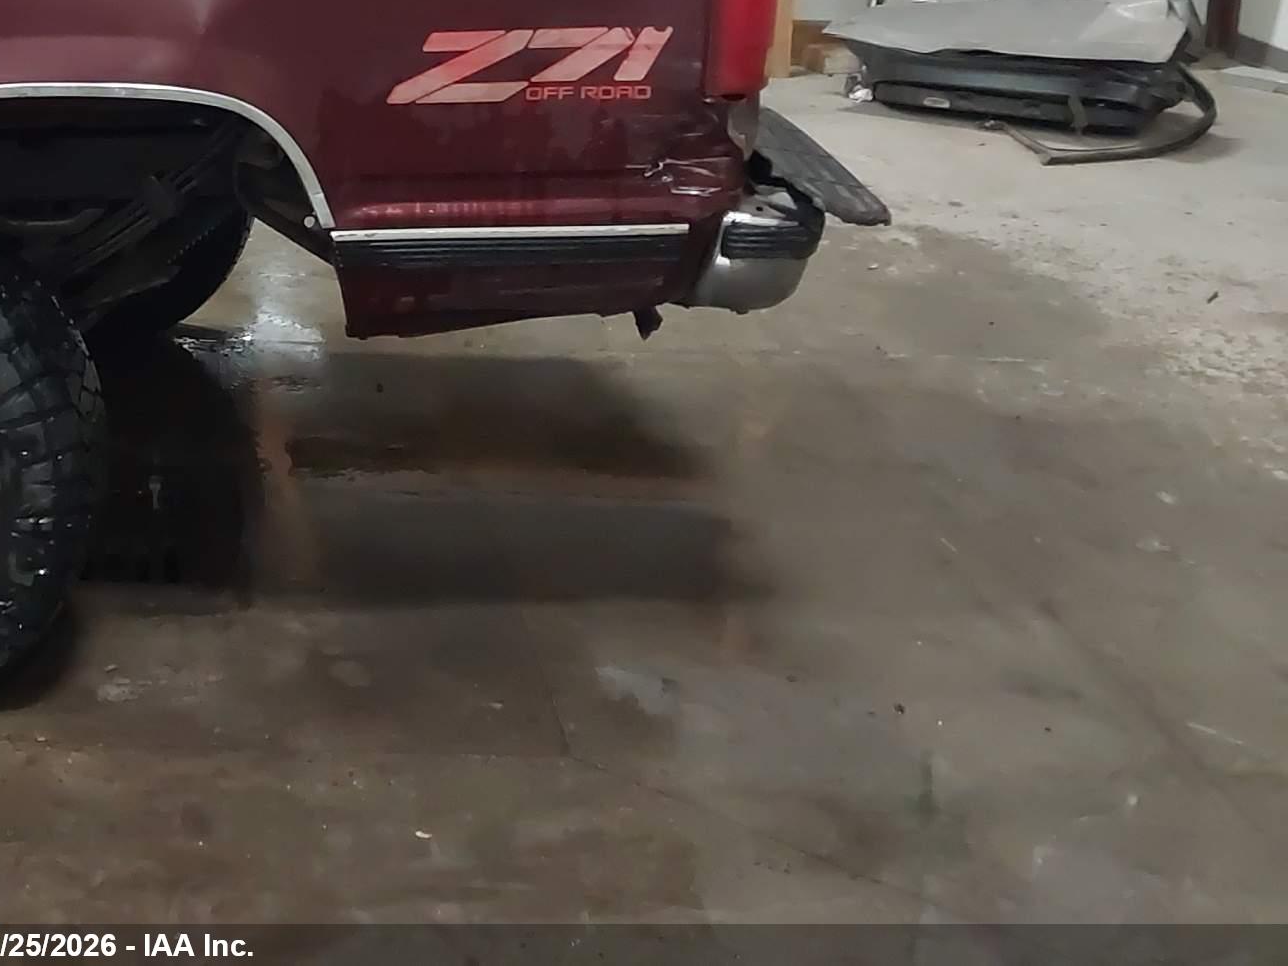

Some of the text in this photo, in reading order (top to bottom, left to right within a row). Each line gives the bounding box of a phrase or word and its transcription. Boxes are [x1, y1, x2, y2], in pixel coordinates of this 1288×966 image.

[386, 26, 674, 104] Z71
[525, 85, 652, 100] OFF ROAD
